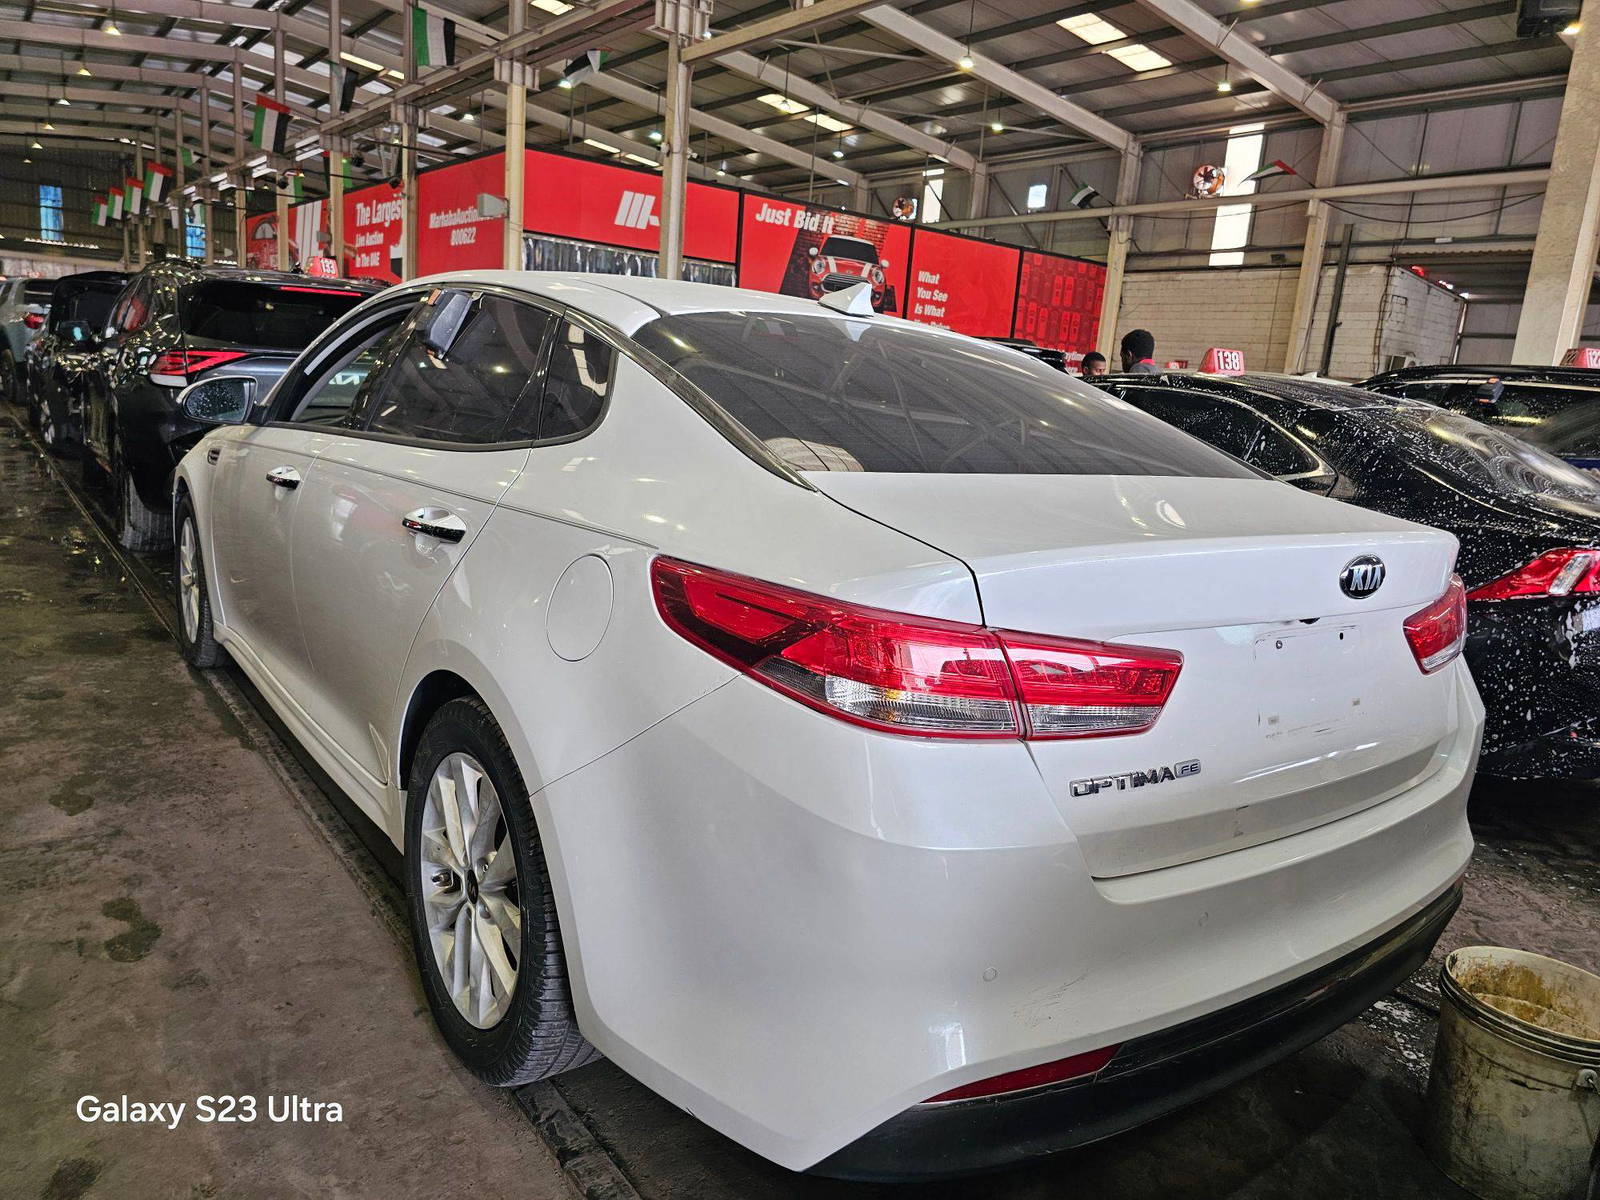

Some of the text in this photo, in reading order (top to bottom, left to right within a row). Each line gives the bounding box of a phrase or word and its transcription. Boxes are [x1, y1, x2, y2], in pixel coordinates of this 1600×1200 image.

[356, 199, 402, 227] The Larges
[755, 203, 834, 234] Just Bid It
[366, 231, 384, 246] Auction
[450, 226, 476, 246] 800622
[321, 259, 337, 274] 133
[361, 253, 370, 267] The
[918, 270, 940, 284] What
[917, 286, 949, 302] You See
[914, 303, 945, 318] Is What
[1217, 351, 1240, 371] 138
[1349, 564, 1383, 591] KIA
[1069, 761, 1200, 797] OPTIMA FE
